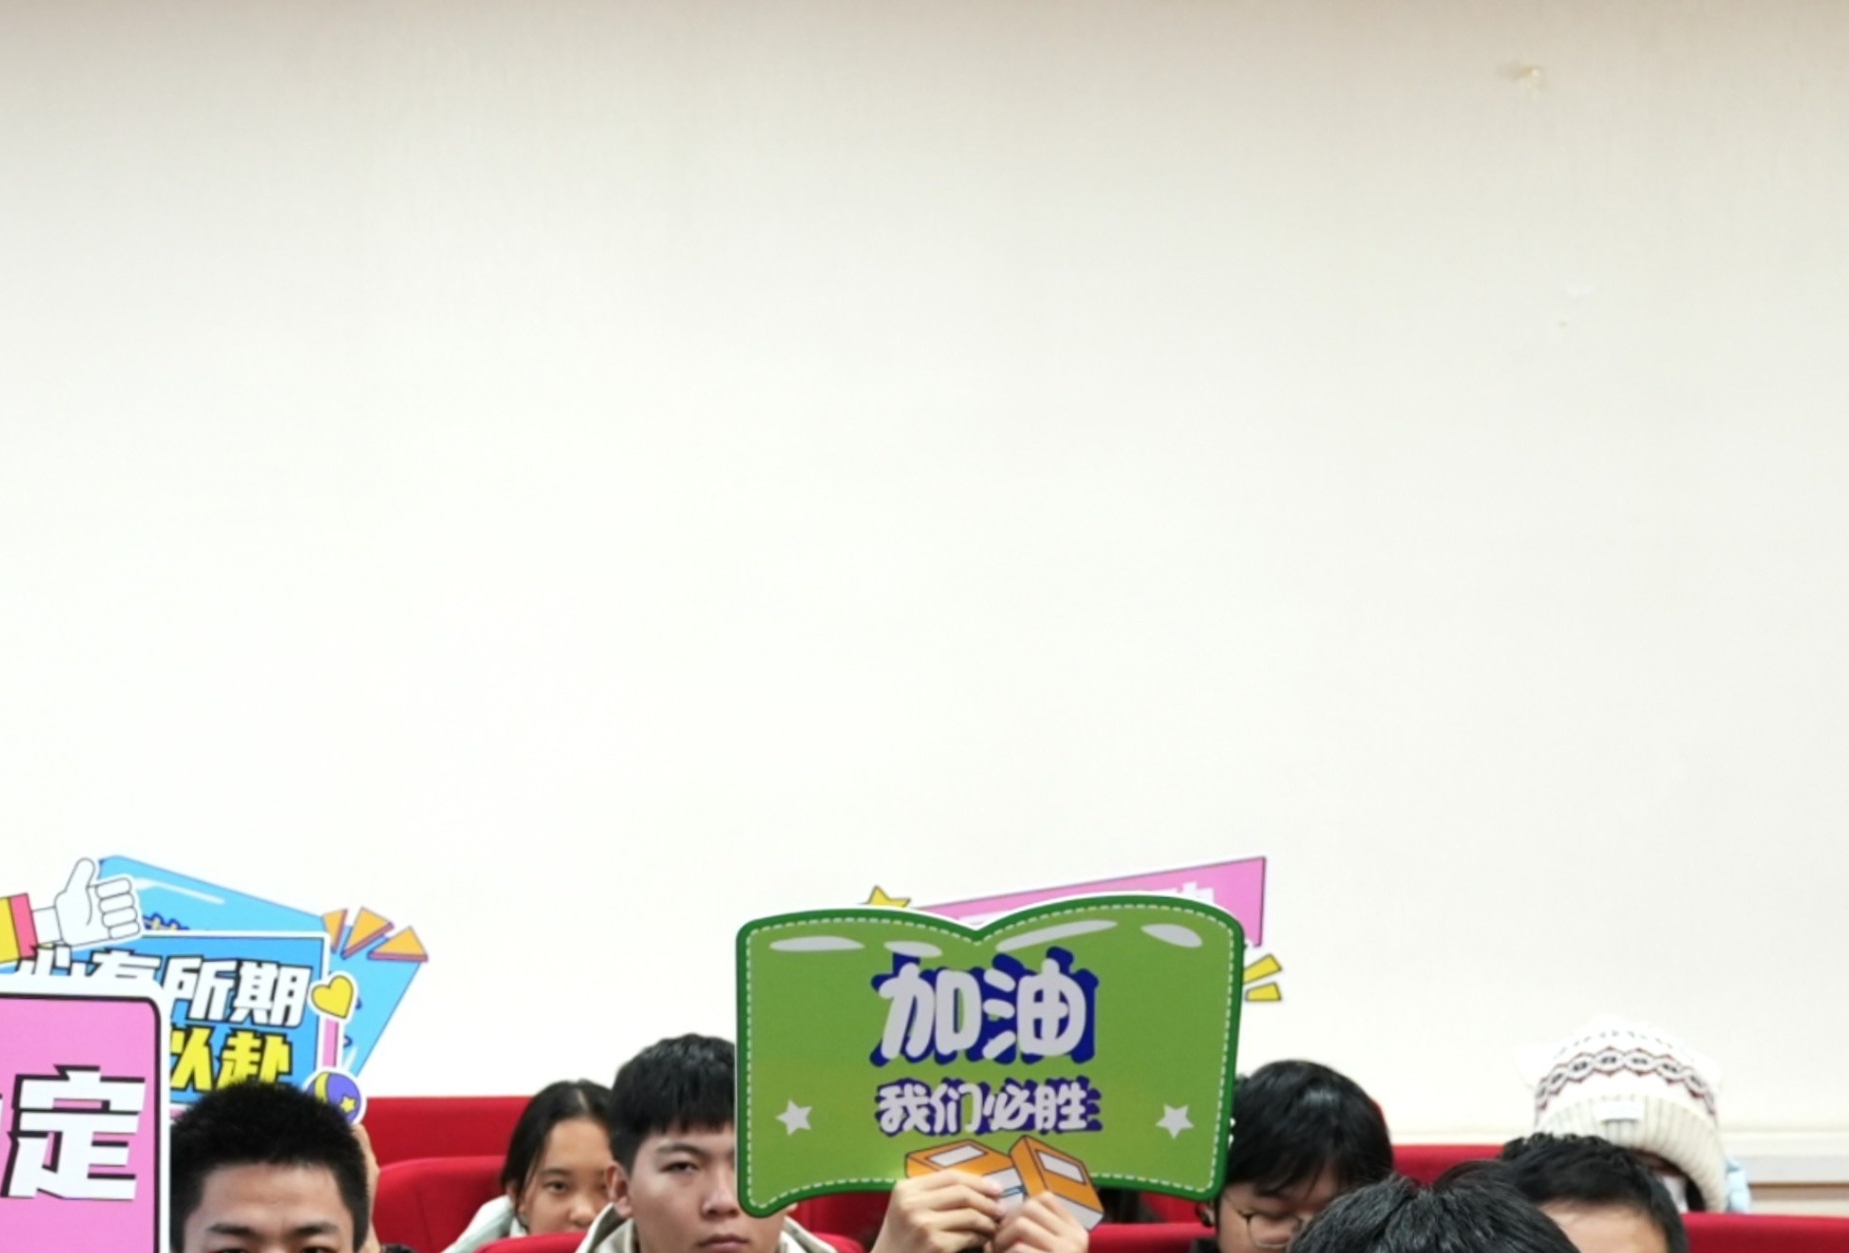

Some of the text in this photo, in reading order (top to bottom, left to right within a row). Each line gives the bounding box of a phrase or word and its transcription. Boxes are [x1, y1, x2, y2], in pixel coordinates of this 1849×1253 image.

[871, 947, 1098, 1064] 加油
[876, 1076, 1101, 1136] 我们必胜
